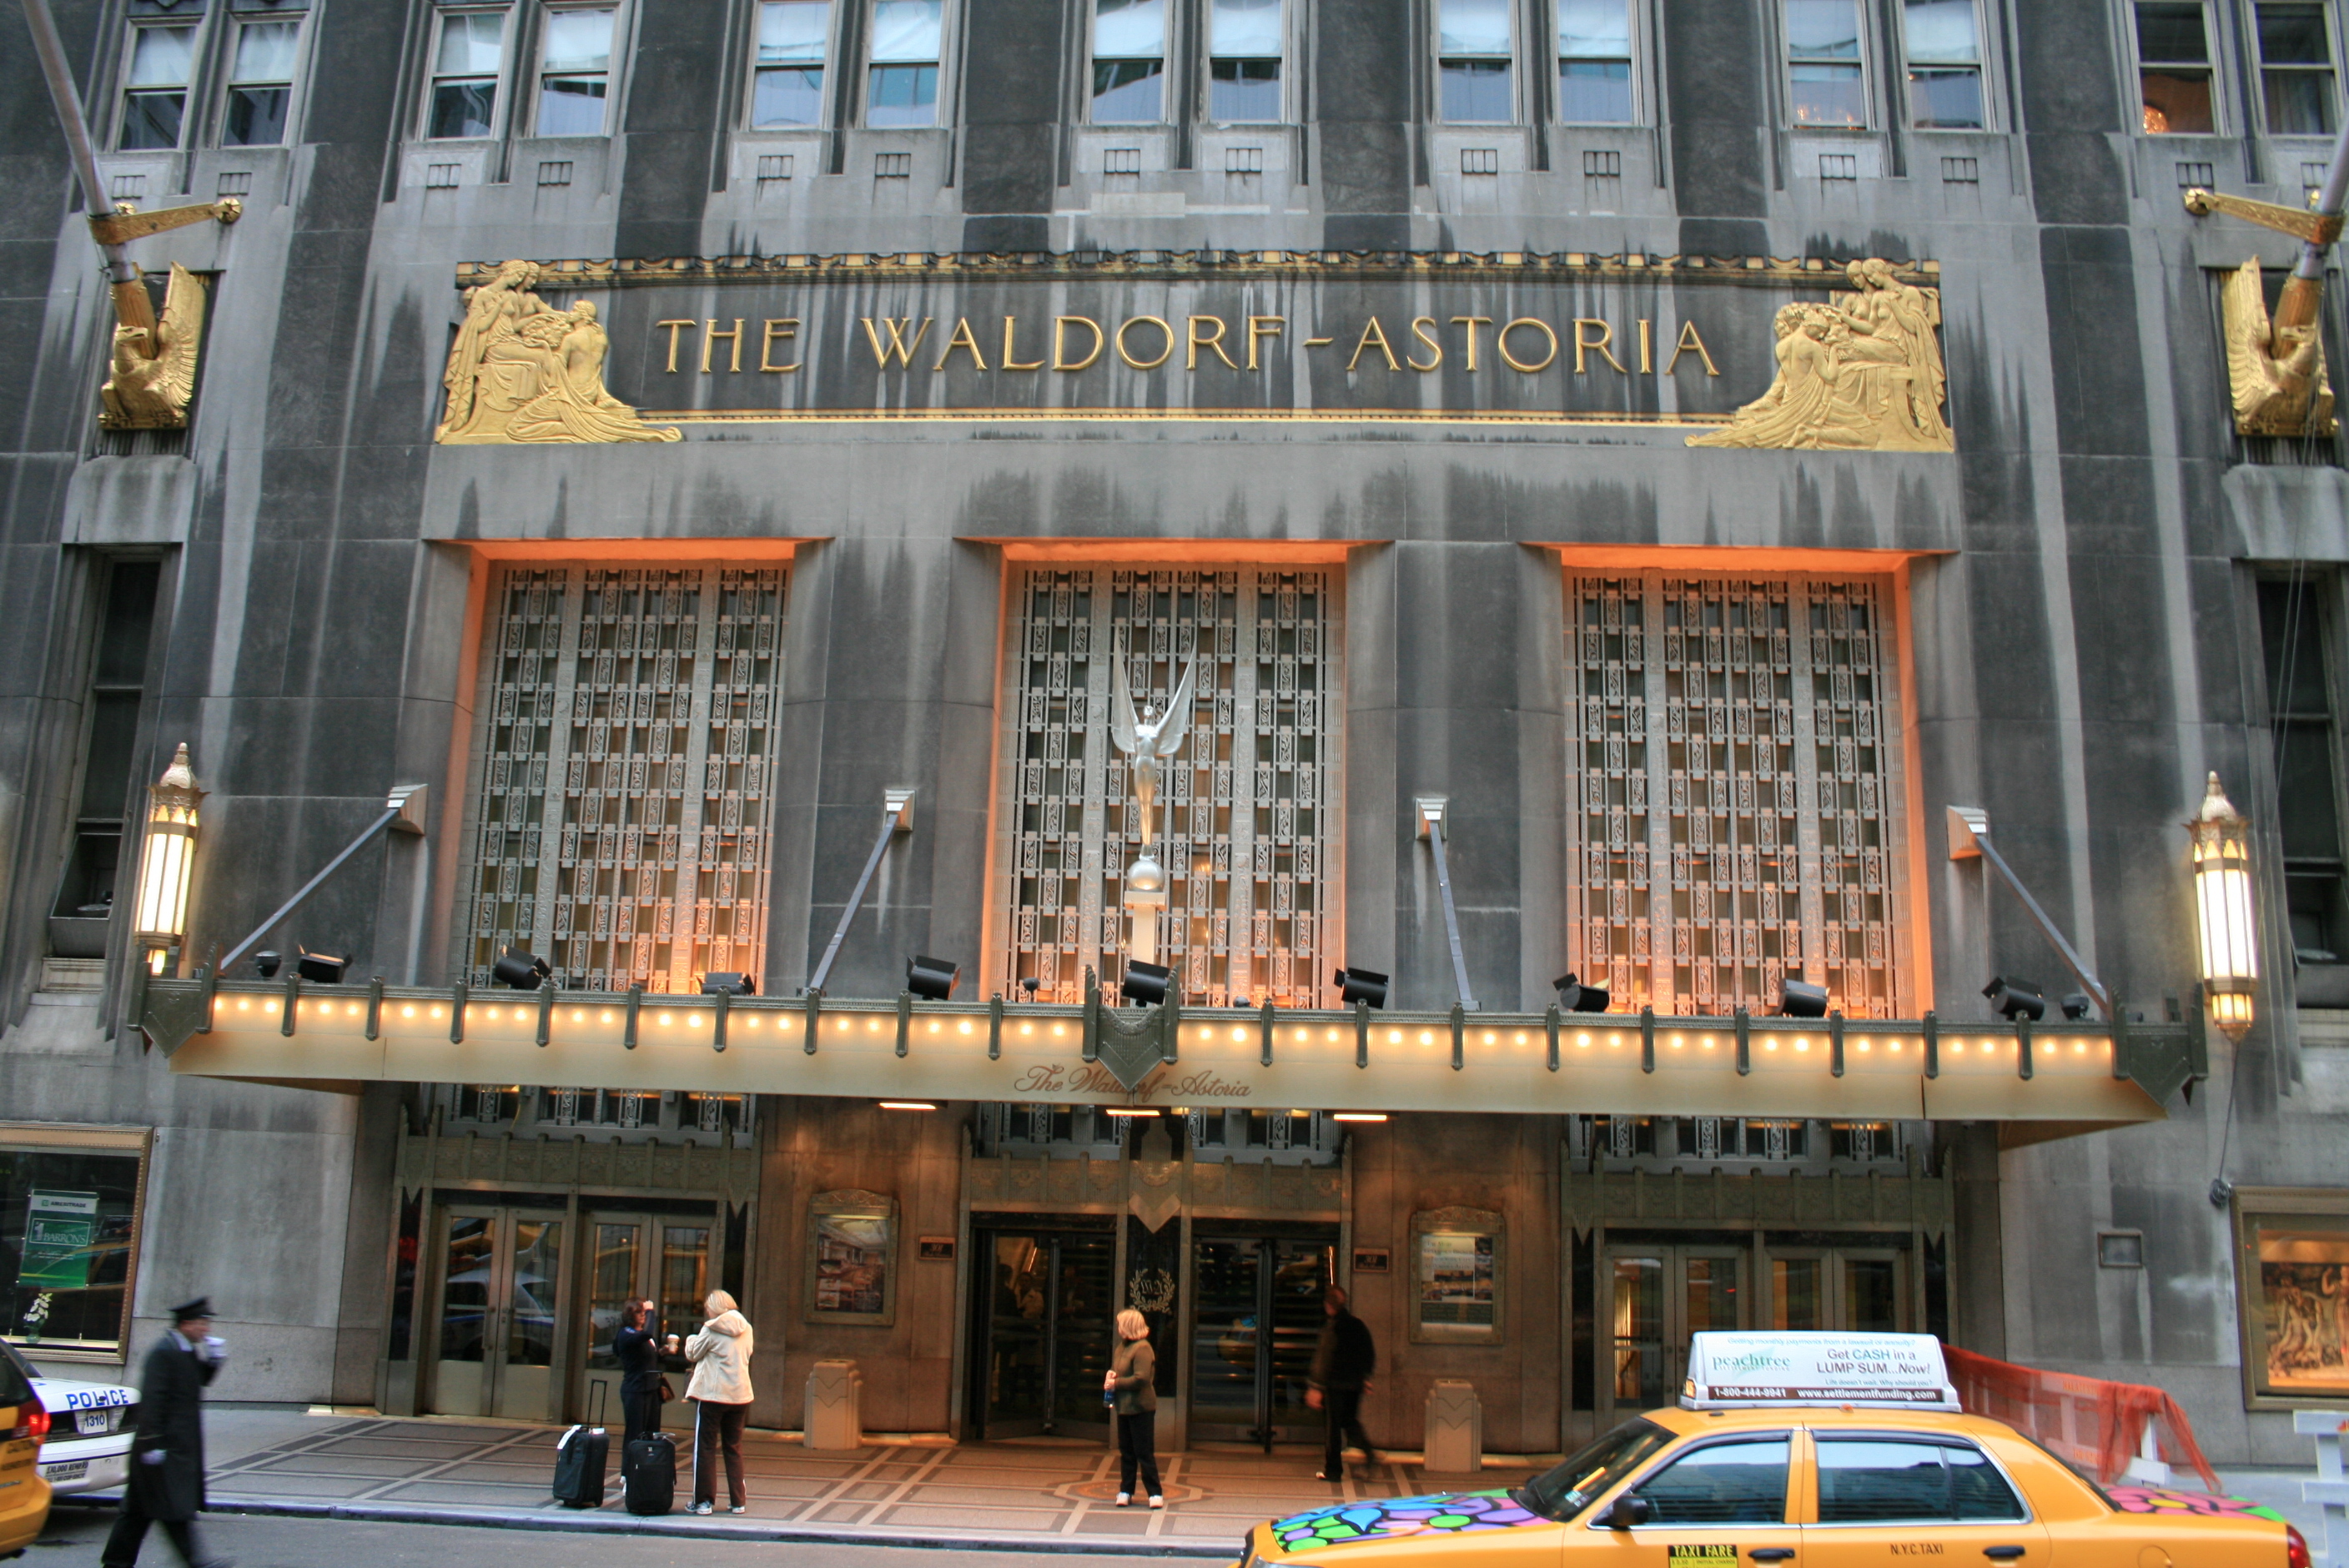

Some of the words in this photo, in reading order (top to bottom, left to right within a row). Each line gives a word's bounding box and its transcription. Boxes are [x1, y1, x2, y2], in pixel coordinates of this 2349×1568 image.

[656, 317, 802, 374] THE
[1014, 1065, 1064, 1093] The
[1827, 1349, 1850, 1360] Get
[1852, 1349, 1891, 1360] CASH
[1893, 1349, 1906, 1360] in
[1909, 1353, 1917, 1361] a
[1713, 1354, 1790, 1370] peachtree
[1816, 1362, 1854, 1374] LUMP
[66, 1389, 128, 1410] POLICE
[1796, 1389, 1937, 1401] www.settlementfunding.com
[85, 1415, 105, 1427] 1310
[1673, 1545, 1700, 1557] TAXI
[1704, 1545, 1733, 1557] FARE
